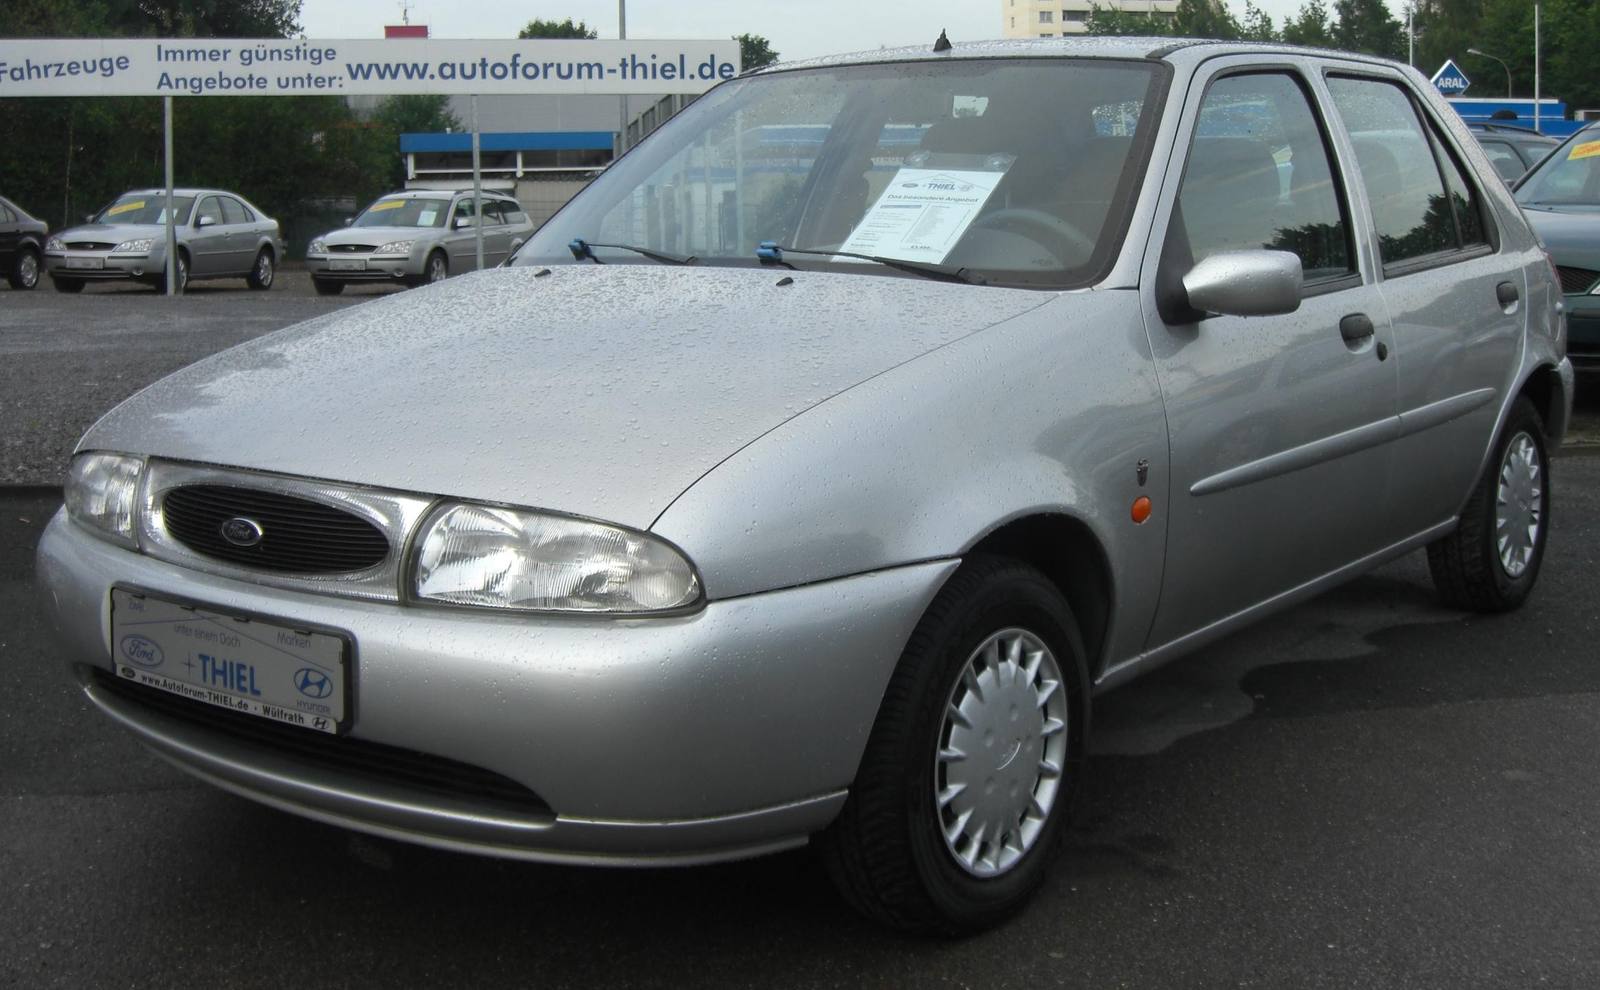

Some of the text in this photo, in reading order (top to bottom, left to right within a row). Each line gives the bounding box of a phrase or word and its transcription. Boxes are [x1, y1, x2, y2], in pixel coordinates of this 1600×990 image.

[156, 43, 337, 66] Immer günstige
[0, 53, 130, 83] Fahrzeuge
[346, 53, 735, 81] www.autoforum-thiel.de
[156, 71, 344, 94] Angebote unter:
[1437, 77, 1465, 89] ARAL
[927, 182, 956, 191] THIEL
[128, 639, 155, 661] Ford
[198, 653, 262, 697] THIEL
[141, 674, 304, 724] www.Autoforum-THIEL.de Wülfrath
